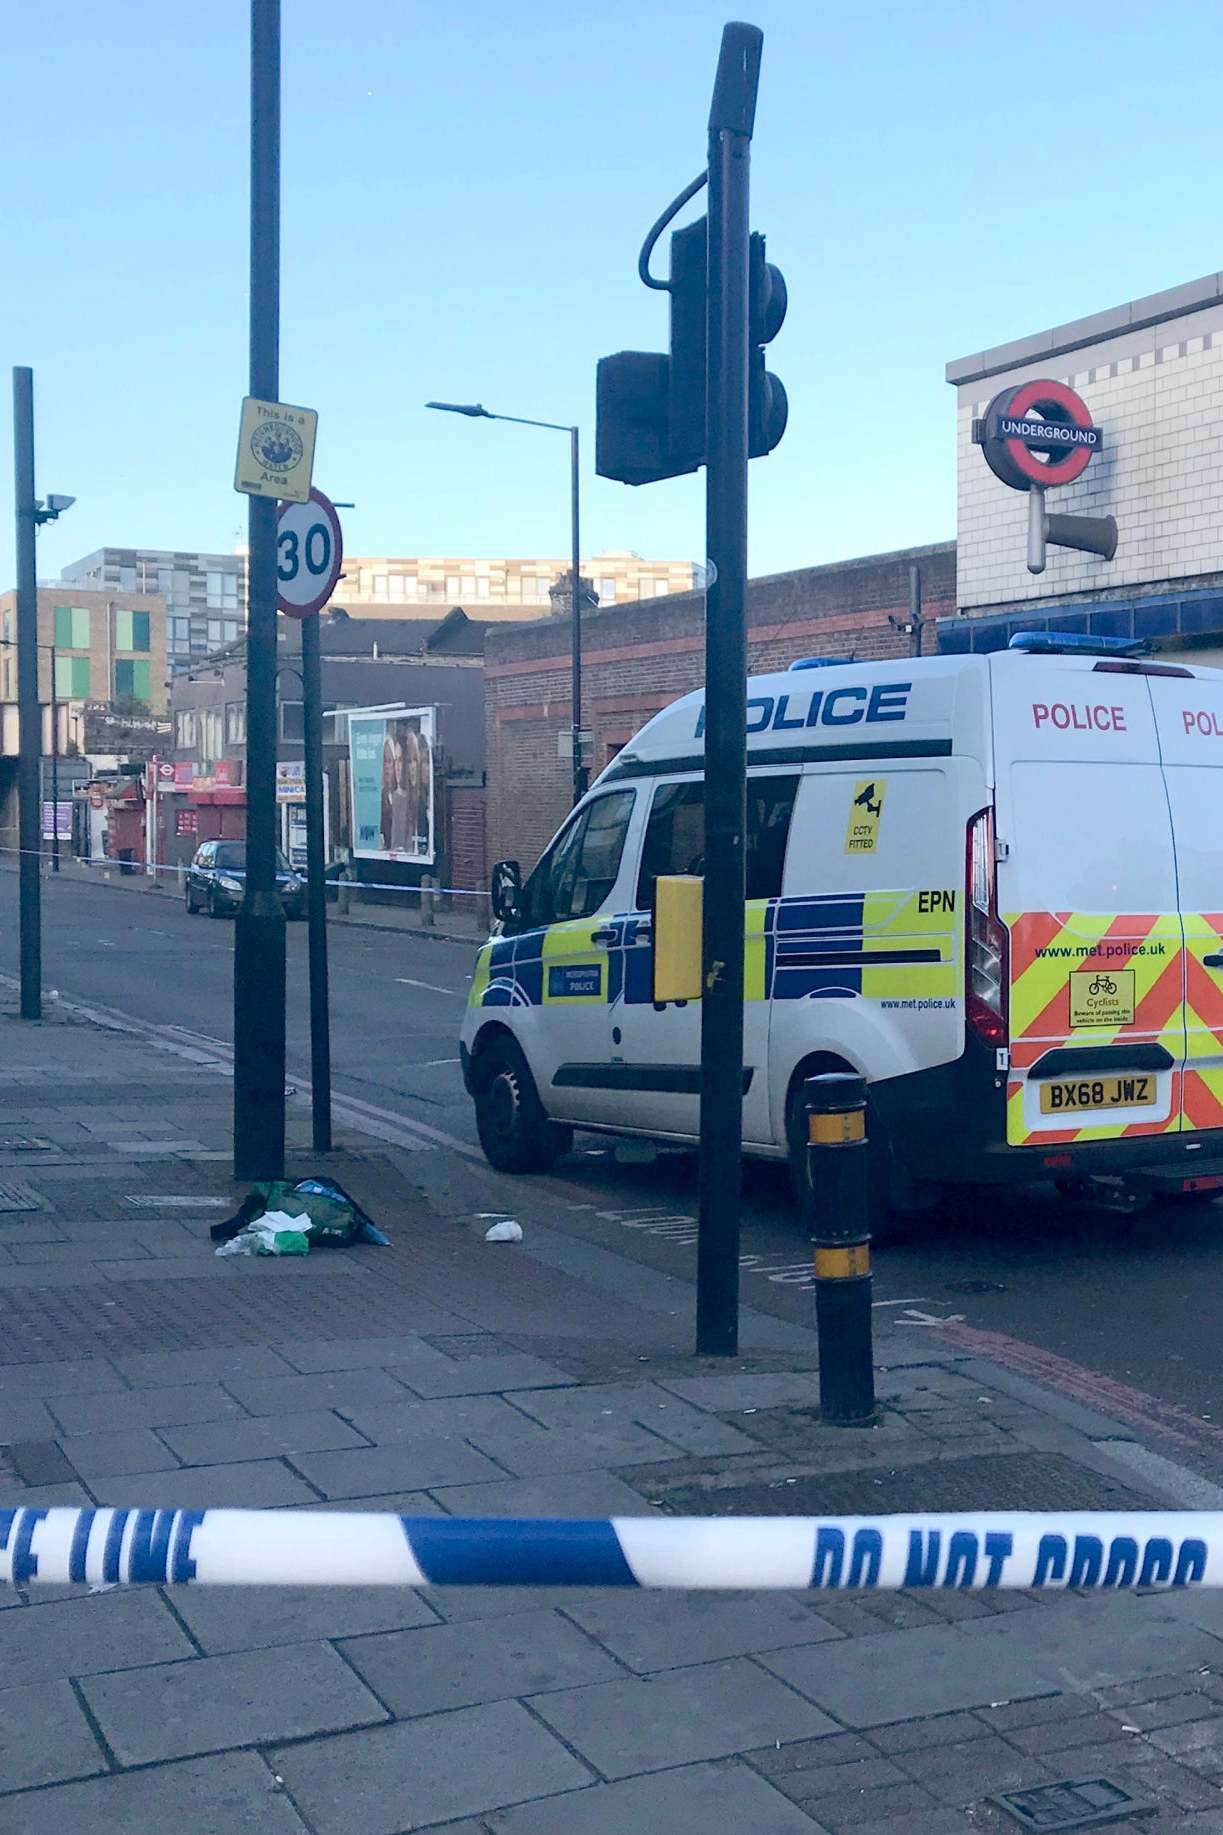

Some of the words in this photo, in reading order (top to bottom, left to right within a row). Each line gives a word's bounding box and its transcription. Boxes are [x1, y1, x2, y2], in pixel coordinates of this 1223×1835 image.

[257, 406, 280, 419] This
[284, 412, 294, 422] is
[298, 417, 305, 425] a
[1001, 420, 1097, 444] UNDERGROUND
[260, 471, 288, 485] Area
[278, 523, 330, 581] 30
[1032, 703, 1127, 731] POLICE
[853, 826, 873, 836] CCTV
[849, 839, 874, 849] FITTED
[918, 890, 956, 913] EPN
[1035, 943, 1166, 959] www.met.police.uk
[880, 999, 956, 1011] www.met.police.uk
[1087, 997, 1120, 1009] Cyclists
[1050, 1082, 1104, 1108] BX68
[1111, 1078, 1149, 1103] JWZ
